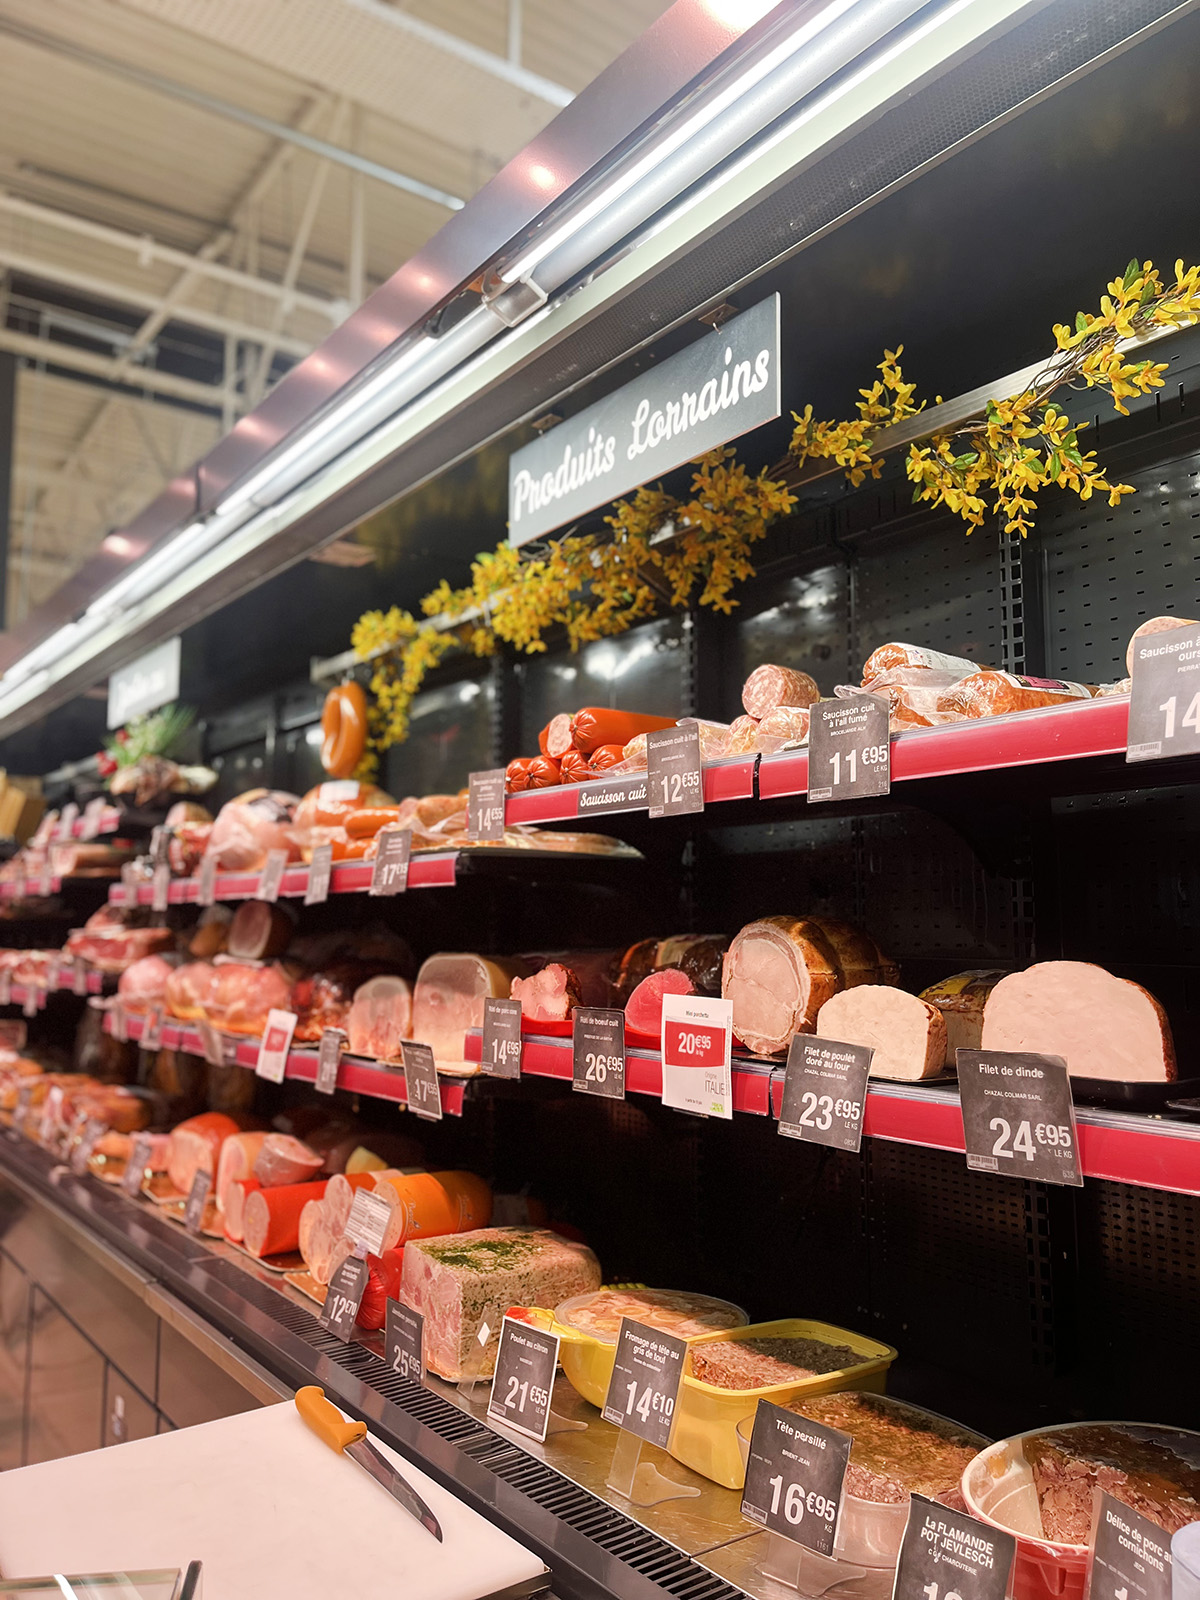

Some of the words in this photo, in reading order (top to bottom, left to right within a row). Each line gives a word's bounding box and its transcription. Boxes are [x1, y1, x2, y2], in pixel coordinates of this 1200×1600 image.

[514, 426, 616, 522] Produits
[626, 346, 770, 461] Lorrains
[1139, 639, 1193, 659] Saucisson
[1177, 663, 1200, 673] PIERRA
[822, 707, 859, 720] Saucisson
[860, 703, 875, 713] cuit
[829, 720, 834, 728] à
[835, 717, 847, 726] l'ail
[848, 713, 868, 724] fumé
[649, 738, 674, 750] Saucisson
[674, 736, 684, 744] cuit
[580, 789, 626, 807] Saucisson
[628, 784, 648, 800] cuit
[804, 1046, 820, 1057] Filet
[821, 1048, 831, 1058] de
[831, 1052, 856, 1063] poulet
[806, 1056, 822, 1066] doré
[823, 1060, 833, 1068] au
[833, 1061, 850, 1072] four
[978, 1063, 999, 1075] Filet
[1001, 1066, 1013, 1076] de
[1016, 1066, 1044, 1078] dinde
[705, 1080, 725, 1096] ITALIE
[1004, 1091, 1027, 1099] COLMAR
[1054, 1149, 1062, 1158] LE
[1063, 1150, 1072, 1159] KG
[510, 1332, 526, 1346] Poulet
[526, 1340, 533, 1348] au
[533, 1341, 548, 1354] citron
[625, 1330, 650, 1348] Fromage
[650, 1341, 658, 1351] de
[658, 1344, 670, 1356] tête
[670, 1350, 680, 1360] au
[633, 1345, 645, 1356] gris
[645, 1350, 653, 1359] de
[776, 1419, 794, 1436] Tête
[794, 1430, 827, 1450] persillé
[798, 1455, 811, 1467] JEAN
[824, 1524, 832, 1534] KG
[925, 1516, 936, 1530] La
[937, 1522, 994, 1555] FLAMANDE
[1106, 1510, 1130, 1536] Délice
[1131, 1528, 1142, 1543] de
[1143, 1537, 1163, 1557] porc
[1164, 1551, 1172, 1564] au
[920, 1527, 940, 1544] POT
[940, 1538, 994, 1569] JEVLESCH
[1118, 1534, 1164, 1572] cornichons
[942, 1554, 977, 1576] CHARCUTERIE
